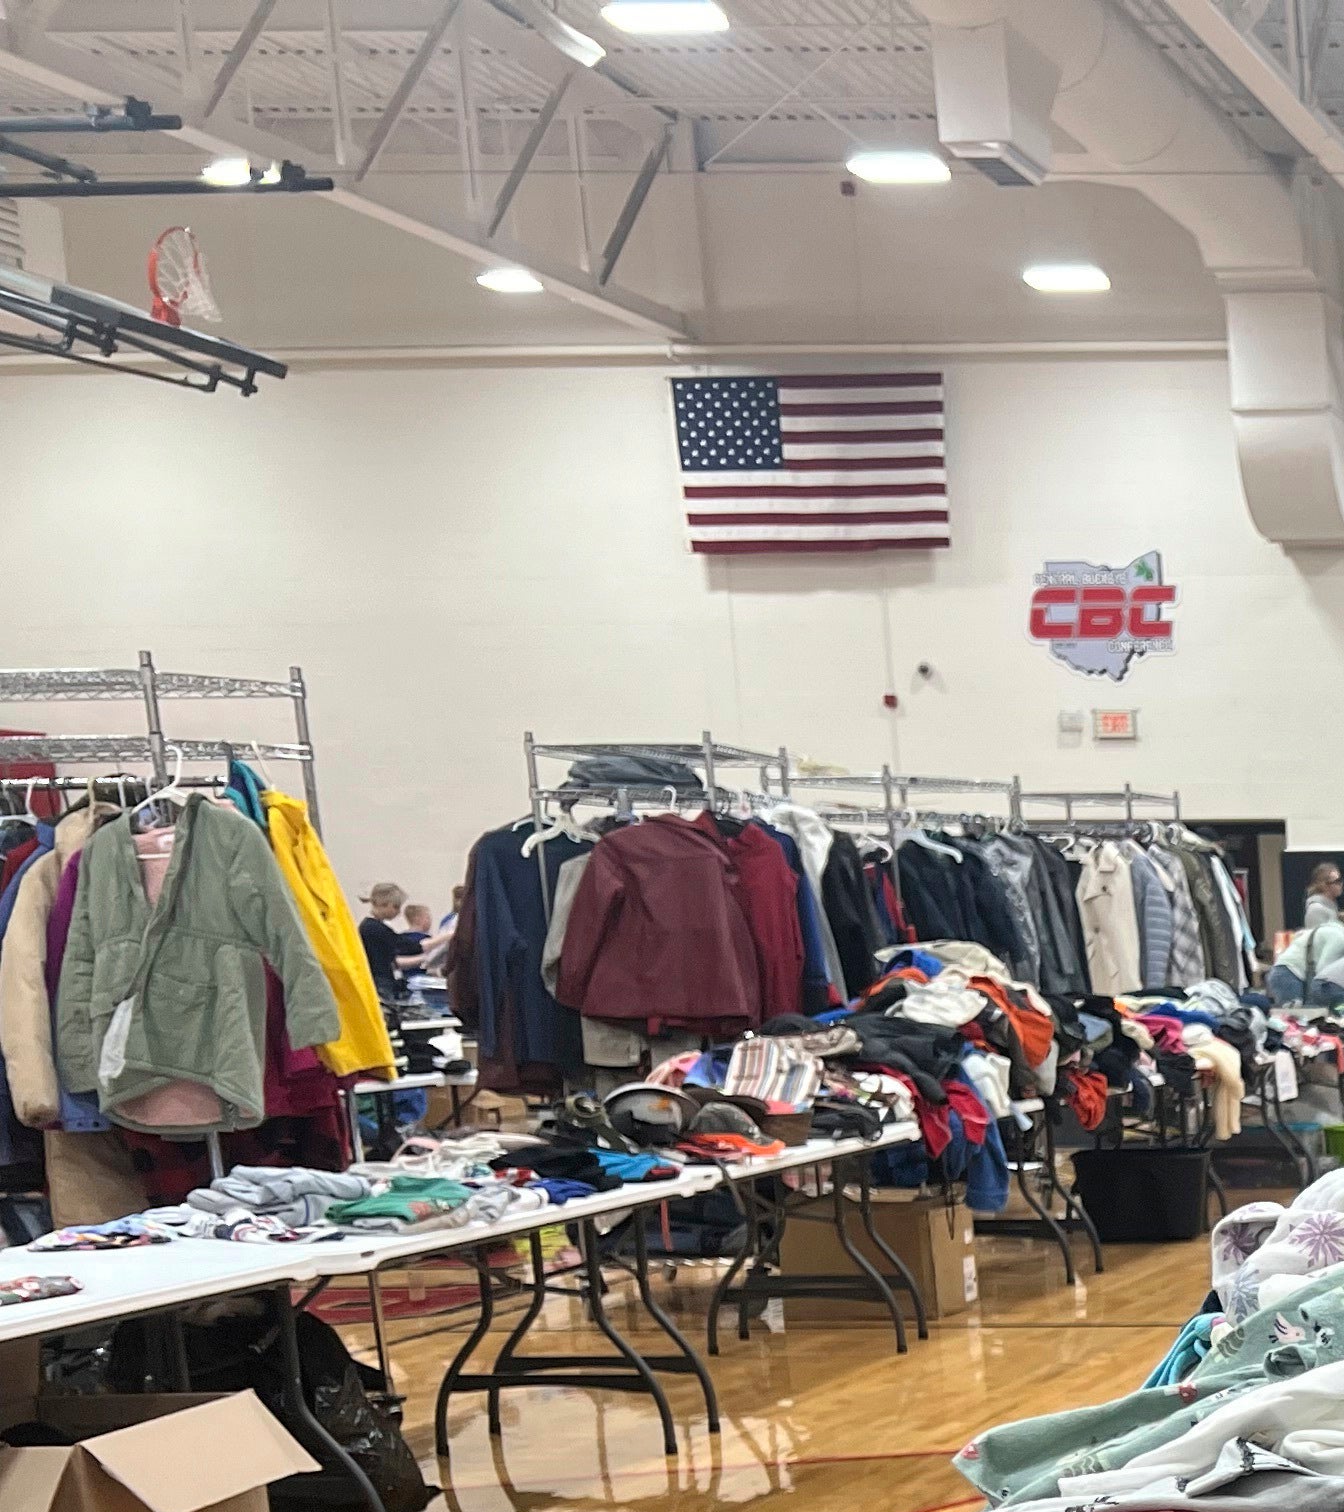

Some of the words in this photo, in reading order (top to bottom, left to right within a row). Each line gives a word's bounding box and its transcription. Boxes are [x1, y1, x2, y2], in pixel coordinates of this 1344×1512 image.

[1032, 572, 1079, 585] CENTRAL
[1082, 571, 1128, 584] BUCKEYE
[1029, 585, 1177, 639] CBC
[1108, 639, 1174, 652] CONFERENCE
